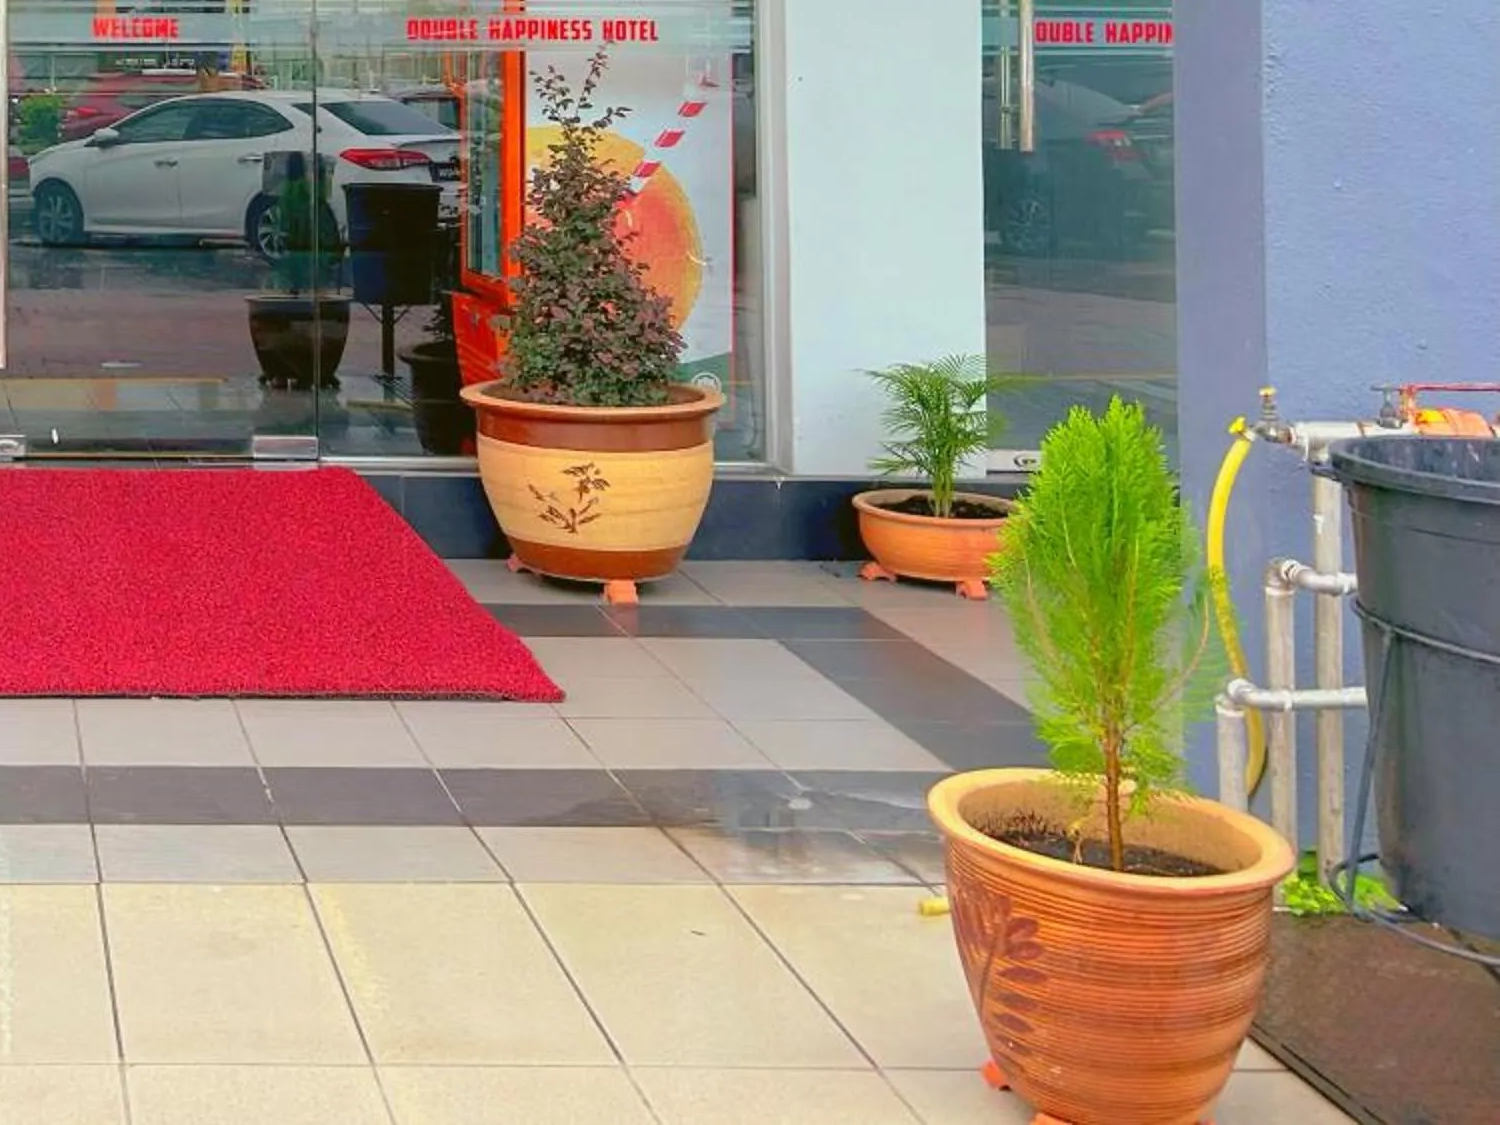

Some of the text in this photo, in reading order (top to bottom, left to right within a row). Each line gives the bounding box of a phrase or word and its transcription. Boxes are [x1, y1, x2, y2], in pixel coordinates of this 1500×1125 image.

[93, 17, 179, 37] WELCOME
[407, 18, 659, 41] DOUBLE HAPPINESS HOTEL
